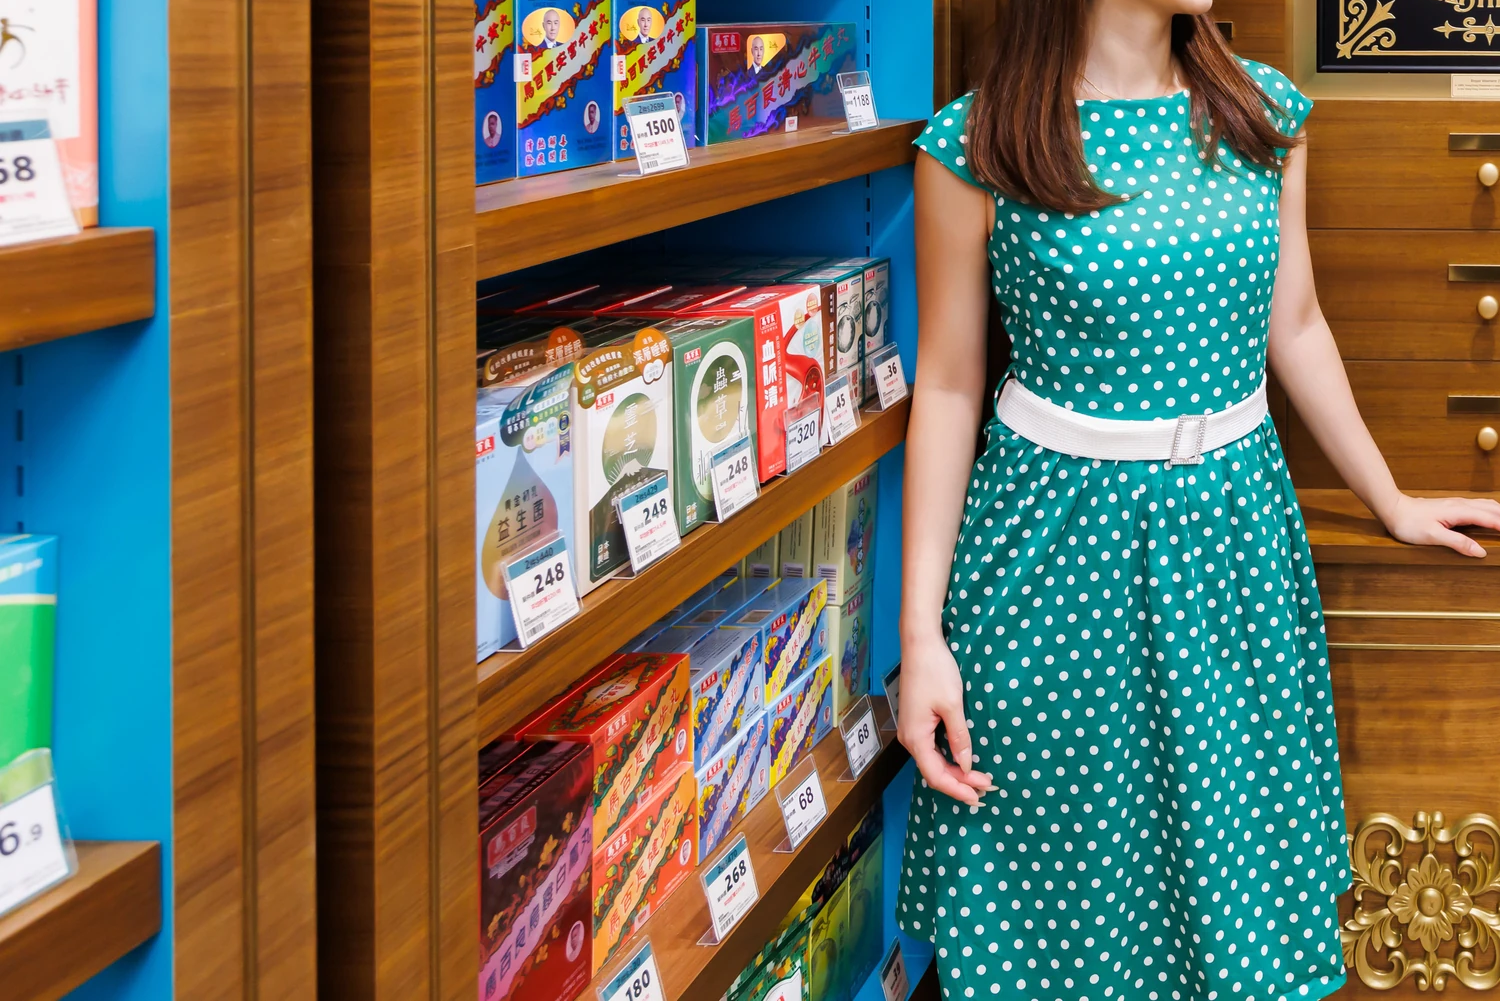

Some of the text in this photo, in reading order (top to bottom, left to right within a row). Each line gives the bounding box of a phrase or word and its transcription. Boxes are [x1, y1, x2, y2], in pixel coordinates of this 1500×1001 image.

[715, 34, 737, 47] 馬百良
[853, 94, 870, 107] 1188
[646, 118, 675, 136] 1500
[762, 340, 779, 410] 血脈清
[887, 362, 897, 378] 36
[714, 367, 728, 420] 蟲草
[836, 393, 846, 408] 45
[797, 420, 816, 444] 320
[727, 455, 748, 480] 248
[497, 498, 545, 542] 益生菌
[642, 498, 668, 525] 248
[534, 561, 565, 594] 248
[857, 723, 869, 744] 68
[798, 786, 814, 811] 68
[724, 859, 747, 893] 268
[625, 969, 650, 1001] 180
